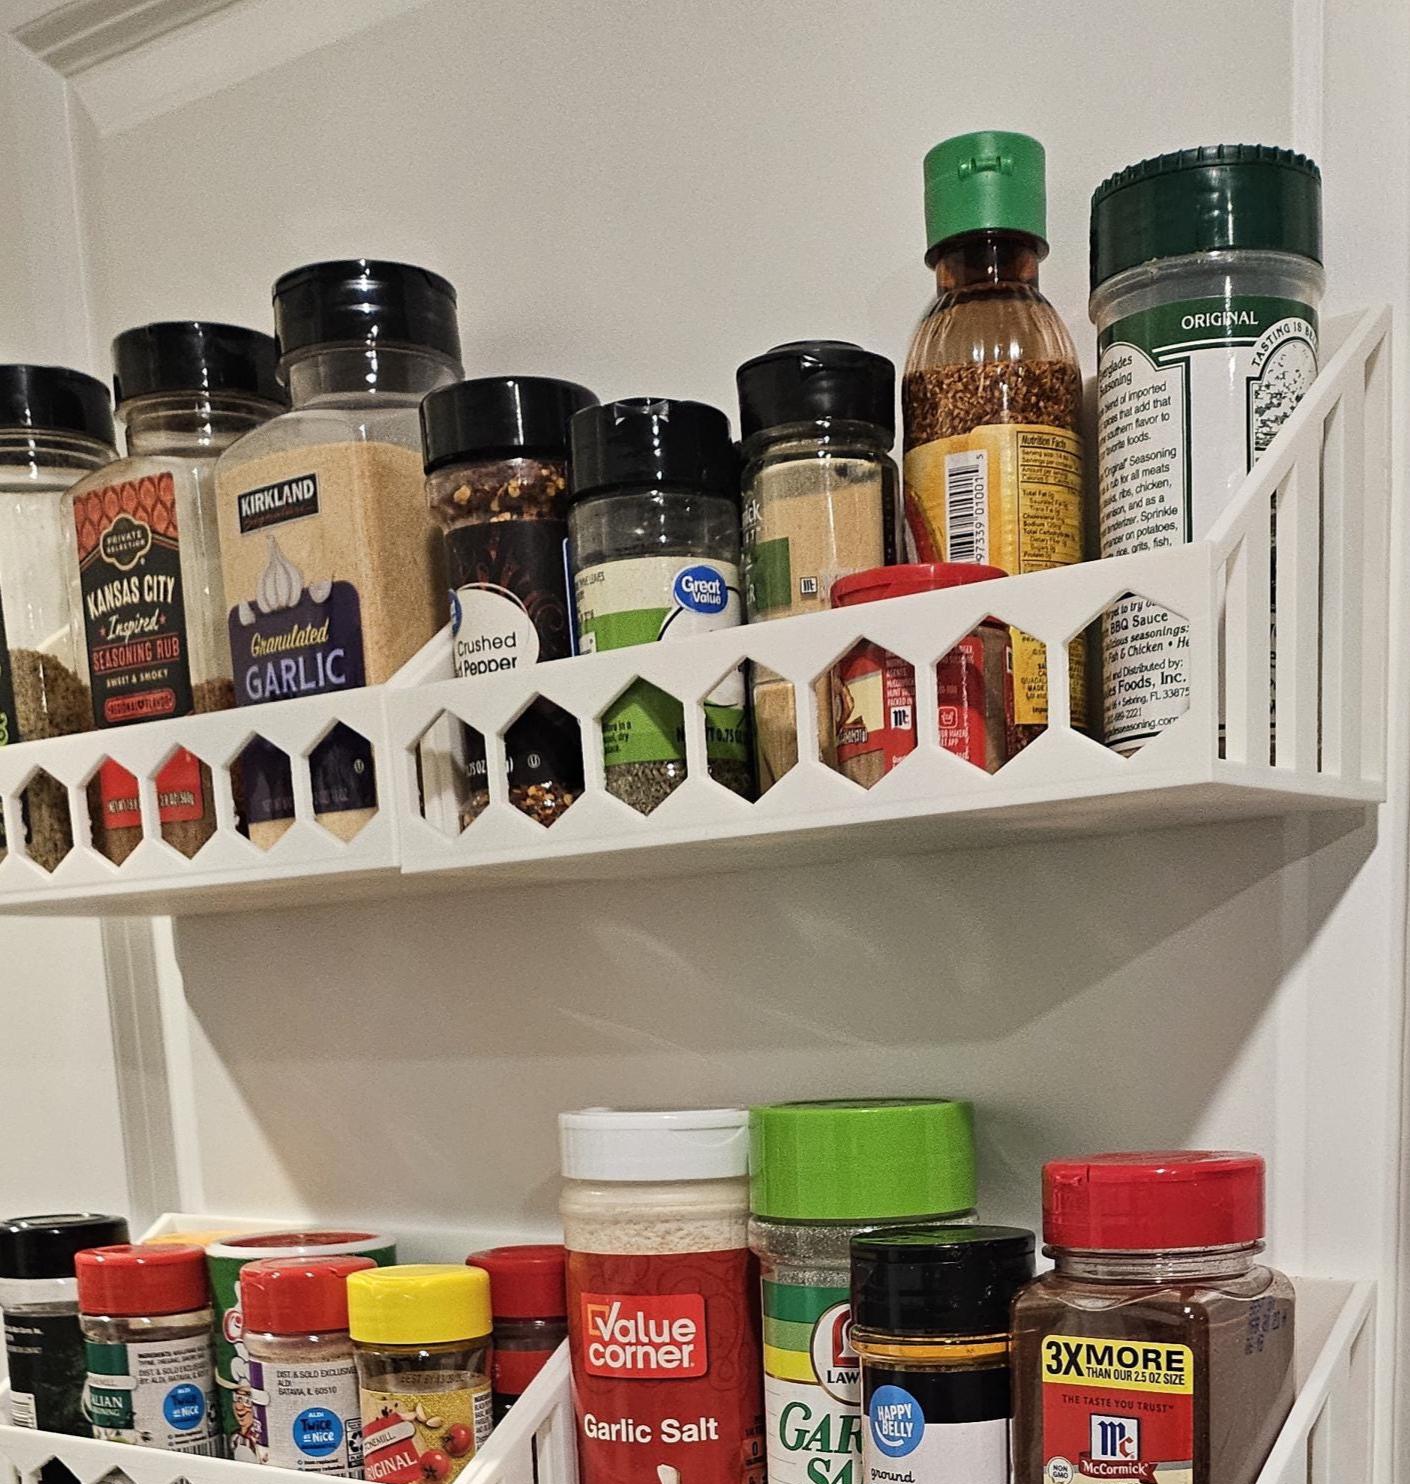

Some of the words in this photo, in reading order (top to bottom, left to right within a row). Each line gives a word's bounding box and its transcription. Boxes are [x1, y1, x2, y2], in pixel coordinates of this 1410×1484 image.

[1181, 311, 1259, 330] ORIGINAL
[1251, 323, 1290, 367] TASTING
[1293, 321, 1302, 332] IS
[1128, 381, 1167, 404] imported
[1119, 406, 1133, 420] that
[1134, 401, 1151, 416] add
[1153, 396, 1172, 409] that
[1135, 416, 1158, 430] flavor
[1161, 411, 1170, 422] to
[1022, 435, 1050, 446] Nutrition
[1050, 437, 1067, 449] Facts
[1127, 431, 1151, 447] foods.
[1129, 447, 1177, 467] Seasoning
[1130, 469, 1140, 481] all
[1142, 463, 1170, 477] meats
[974, 477, 984, 515] 01001
[1135, 479, 1172, 495] chicken,
[241, 478, 315, 517] KIRKLAND
[1128, 497, 1143, 510] and
[1145, 497, 1156, 506] as
[1159, 494, 1165, 503] a
[1140, 506, 1178, 523] Sprinkle
[106, 529, 143, 546] PRIVATE
[1125, 530, 1135, 541] on
[1136, 521, 1178, 540] potatoes,
[1153, 536, 1172, 548] fish,
[681, 575, 721, 594] Great
[87, 575, 140, 620] KANSAS
[143, 574, 175, 604] CITY
[693, 591, 722, 605] Value
[106, 608, 160, 644] Inspired
[1110, 618, 1129, 635] BBQ
[1132, 612, 1169, 628] Sauce
[250, 617, 329, 658] Granulated
[1130, 624, 1190, 643] seasonings:
[457, 631, 517, 657] Crushed
[1127, 641, 1163, 658] Chicken
[93, 640, 153, 672] SEASONING
[156, 637, 180, 657] RUB
[139, 668, 169, 682] SMOKY
[245, 648, 346, 700] GARLIC
[464, 656, 518, 677] Pepper
[1123, 659, 1166, 677] Distributed
[1168, 658, 1184, 671] by:
[1118, 675, 1156, 694] Foods,
[1160, 671, 1187, 685] Inc.
[1150, 691, 1161, 702] FL
[595, 1301, 697, 1343] Value
[589, 1342, 694, 1369] corner
[1046, 1341, 1084, 1377] 3X
[1085, 1343, 1185, 1372] MORE
[1086, 1367, 1111, 1380] THAN
[1114, 1369, 1133, 1381] OUR
[1134, 1371, 1147, 1382] 2.5
[1148, 1372, 1161, 1384] OZ
[1164, 1373, 1185, 1386] SIZE
[1062, 1394, 1080, 1404] THE
[1084, 1397, 1111, 1407] TASTE
[1114, 1399, 1134, 1409] YOU
[877, 1403, 912, 1421] HAPPY
[300, 1419, 332, 1431] Twice
[584, 1413, 652, 1443] Garlic
[661, 1417, 719, 1443] Salt
[779, 1401, 863, 1454] GAR
[882, 1422, 913, 1437] BELLY
[312, 1432, 335, 1442] Nice
[871, 1468, 915, 1484] ground
[1053, 1464, 1068, 1472] NON
[1053, 1471, 1069, 1479] GMO
[1082, 1460, 1148, 1476] McCormick
